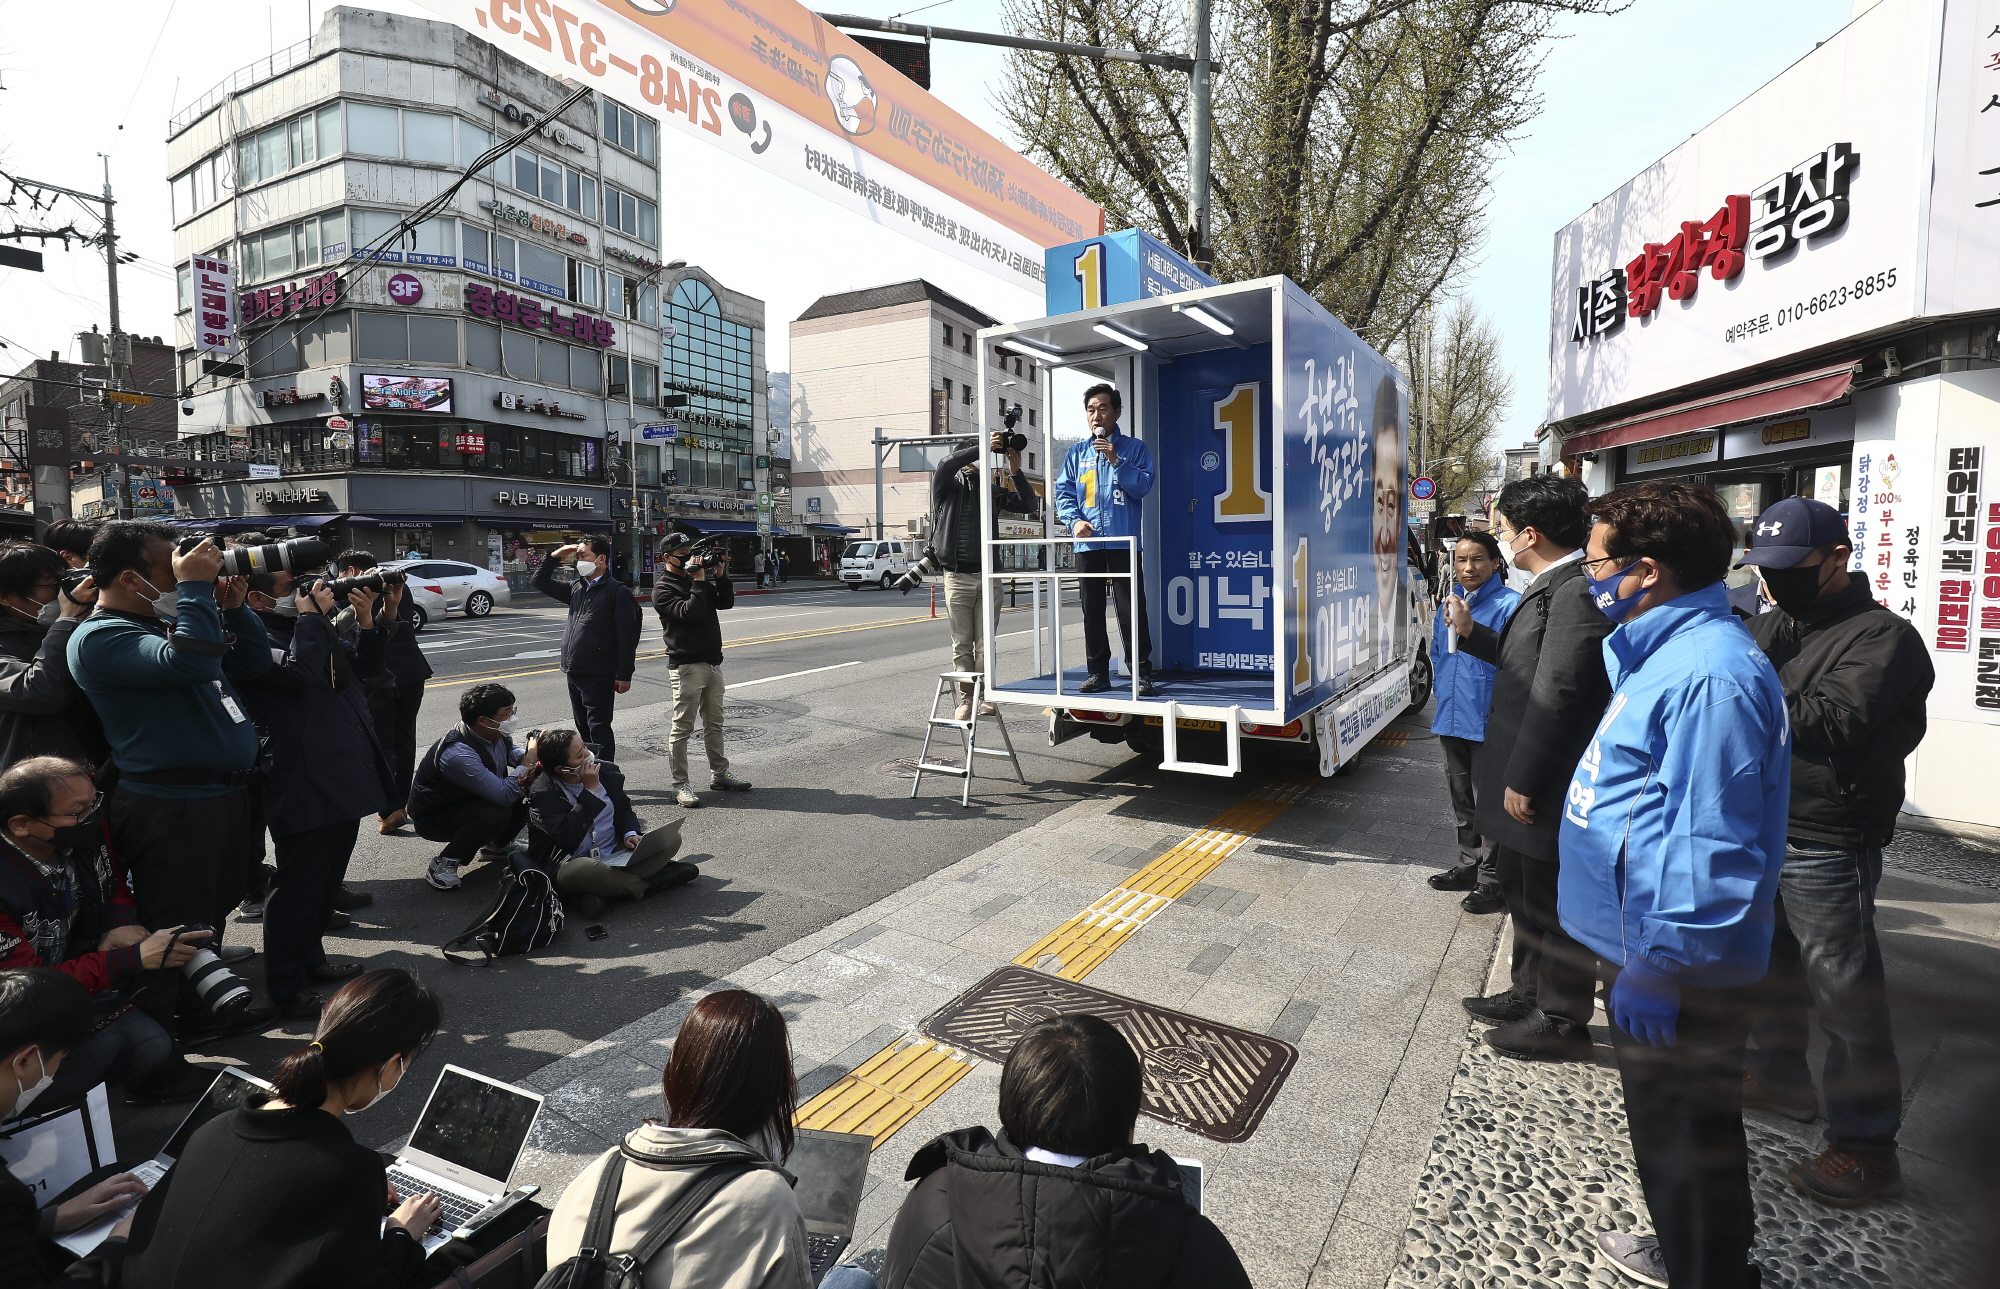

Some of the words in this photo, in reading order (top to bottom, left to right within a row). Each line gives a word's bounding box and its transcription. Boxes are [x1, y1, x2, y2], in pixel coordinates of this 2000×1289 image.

[491, 198, 530, 227] 김준영
[530, 213, 568, 240] 철학원
[1569, 267, 1628, 343] 서촌
[1624, 194, 1751, 319] 닭강정
[1749, 142, 1861, 261] 공장
[194, 257, 229, 275] 경희궁
[390, 280, 419, 297] 3F
[1074, 242, 1108, 311] 1
[1147, 249, 1179, 285] 서울대학교
[200, 273, 230, 330] 노래방
[240, 284, 286, 323] 경희궁
[289, 271, 339, 312] 노래방
[468, 282, 545, 329] 경희궁
[550, 306, 616, 348] 노래방
[1724, 313, 1773, 345] 예약주문.
[1776, 267, 1898, 328] 010-6623-8855
[466, 435, 485, 447] 호프
[1213, 381, 1274, 524] 1
[276, 488, 320, 504] 파리바게뜨
[536, 493, 595, 510] 파리바게뜨
[712, 501, 746, 512] 이디야커피
[1856, 453, 1872, 514] 닭강정
[1873, 492, 1902, 505] 100%
[1943, 446, 1981, 542] 태어나서
[1188, 551, 1203, 569] 할
[1204, 551, 1222, 569] 수
[1875, 509, 1895, 591] 부드러운
[1903, 525, 1921, 589] 정육만
[1941, 549, 1973, 572] 꼭
[1332, 566, 1358, 594] 있습니다!
[1292, 537, 1312, 696] 1
[1315, 594, 1370, 683] 이낙연
[1936, 579, 1972, 650] 한번은
